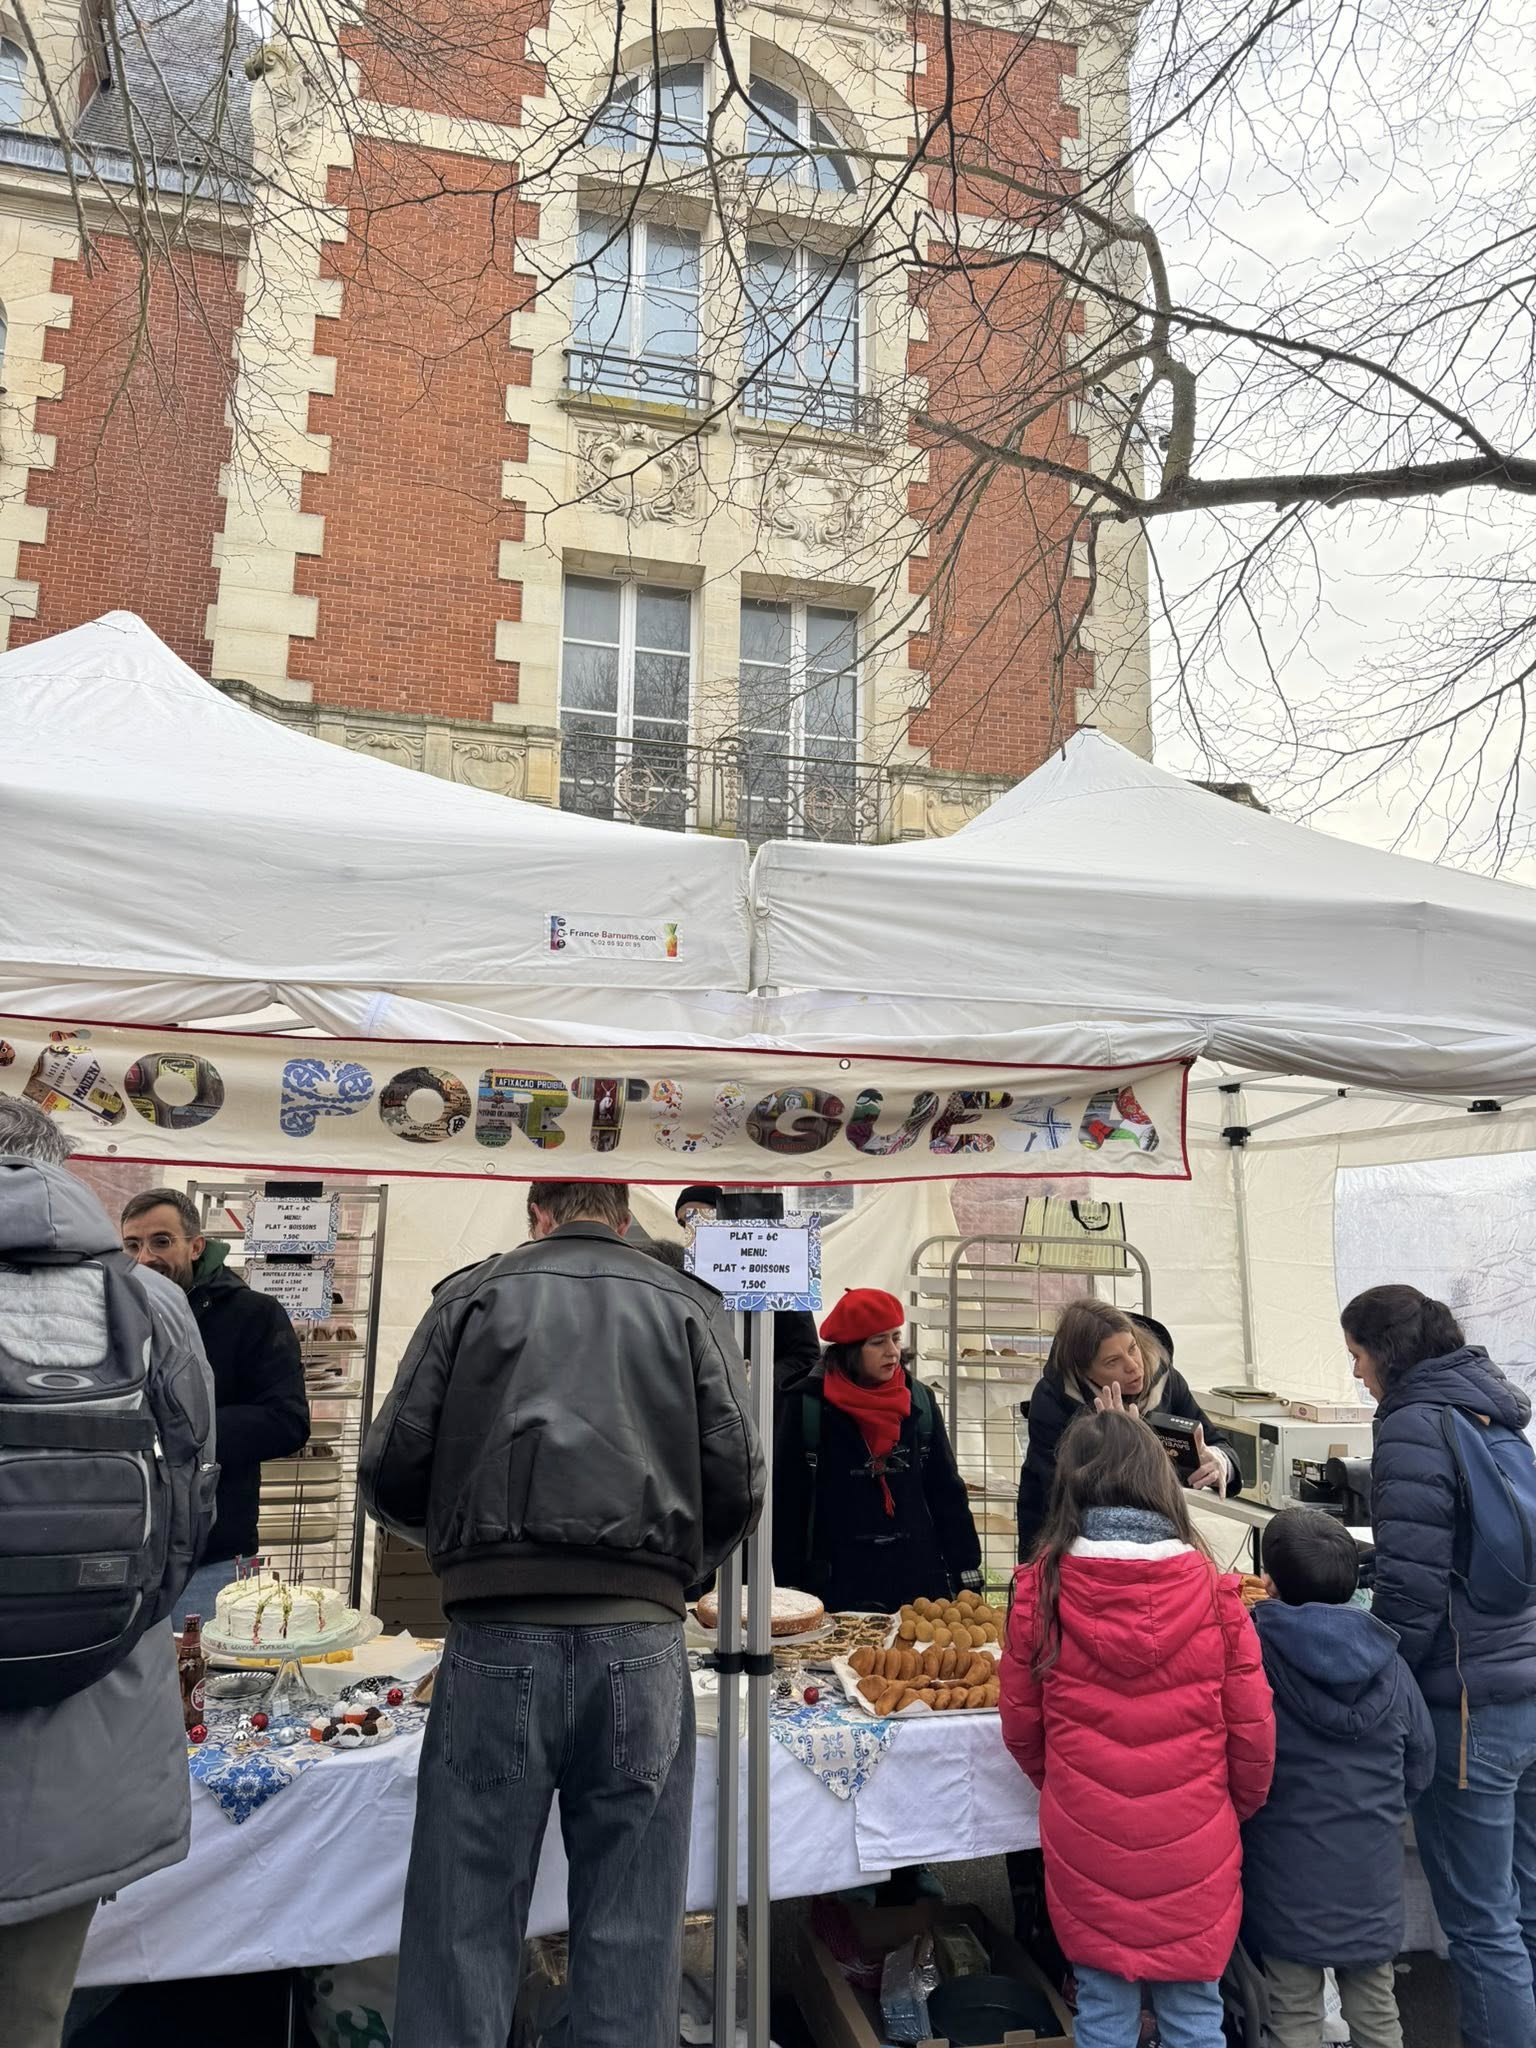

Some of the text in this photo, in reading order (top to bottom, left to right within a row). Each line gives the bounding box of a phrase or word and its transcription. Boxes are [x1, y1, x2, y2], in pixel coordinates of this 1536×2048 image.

[569, 929, 656, 941] France Barnums.com
[279, 1057, 1160, 1156] PORTUGUESA
[729, 1232, 754, 1241] PLAT
[766, 1232, 778, 1241] 6€
[740, 1248, 768, 1257] MENU:
[713, 1264, 737, 1273] PLAT
[748, 1264, 790, 1274] BOISSONS
